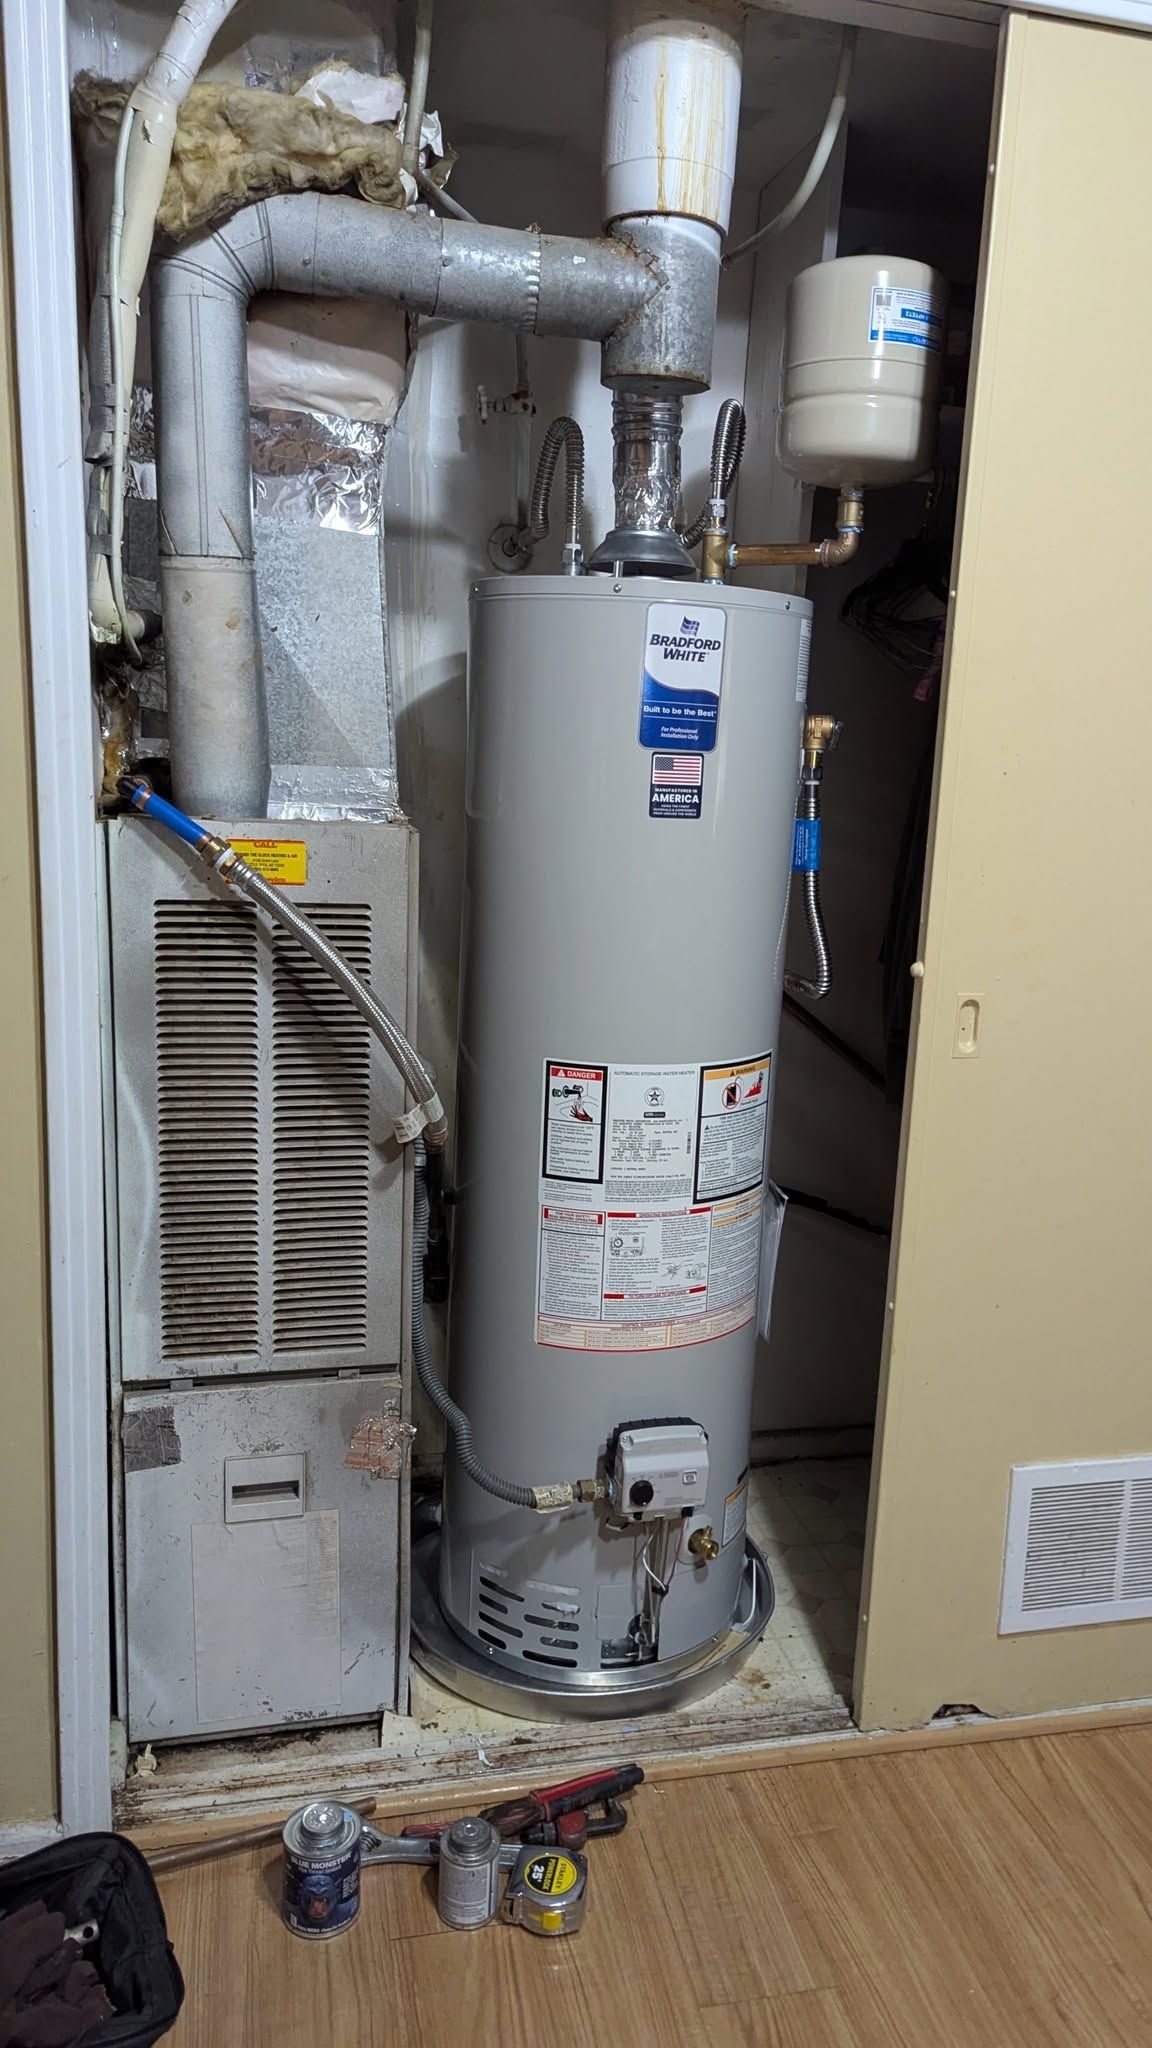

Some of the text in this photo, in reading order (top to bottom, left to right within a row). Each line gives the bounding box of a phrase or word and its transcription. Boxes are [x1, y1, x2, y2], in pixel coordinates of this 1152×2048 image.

[649, 633, 722, 651] BRADFORD
[663, 647, 706, 663] WHITE
[643, 705, 660, 713] Built
[662, 706, 670, 714] to
[671, 707, 682, 715] be
[683, 708, 695, 716] the
[669, 726, 698, 734] Professional
[652, 793, 700, 804] AMERICA
[254, 841, 278, 849] CALL
[567, 1070, 596, 1079] DANGER
[290, 1851, 352, 1869] BLUE MONSTER
[542, 1858, 556, 1891] POWERLOCK
[555, 1863, 567, 1889] STANLEY
